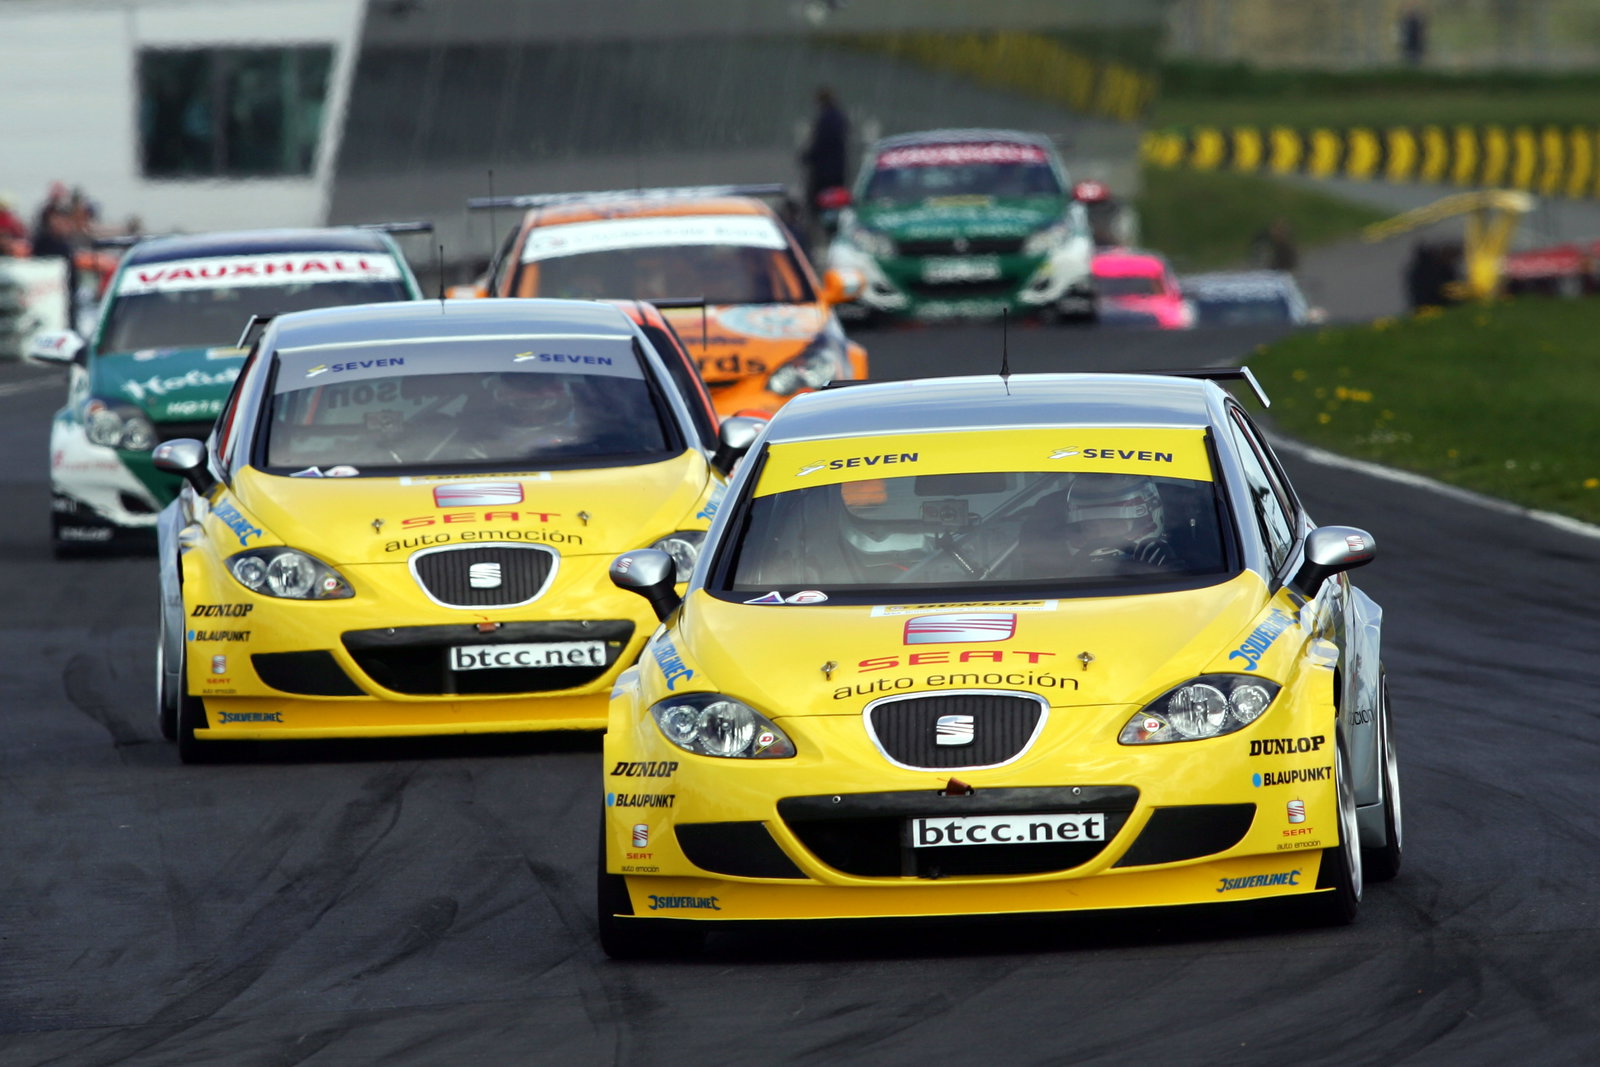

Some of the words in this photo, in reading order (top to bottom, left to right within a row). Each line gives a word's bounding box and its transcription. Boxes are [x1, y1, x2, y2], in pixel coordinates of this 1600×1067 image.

[138, 258, 383, 285] VAUXHALL
[332, 357, 405, 373] SEVEN
[539, 353, 613, 366] SEVEN
[829, 452, 919, 471] SEVEN
[1082, 448, 1173, 463] SEVEN
[401, 511, 561, 530] SEAT
[385, 532, 451, 553] auto
[460, 528, 583, 546] emoción
[191, 603, 253, 617] DUNLOP
[196, 630, 251, 642] BLAUPUNKT
[455, 646, 602, 669] btcc.net
[858, 649, 1057, 674] SEAT
[832, 673, 914, 701] auto
[926, 669, 1079, 692] emoción
[1249, 735, 1325, 757] DUNLOP
[610, 761, 679, 778] DUNLOP
[1263, 766, 1332, 787] BLAUPUNKT
[616, 794, 676, 808] BLAUPUNKT
[918, 816, 1100, 846] btcc.net
[1282, 828, 1314, 838] SEAT
[1277, 842, 1293, 851] auto
[626, 852, 653, 860] SEAT
